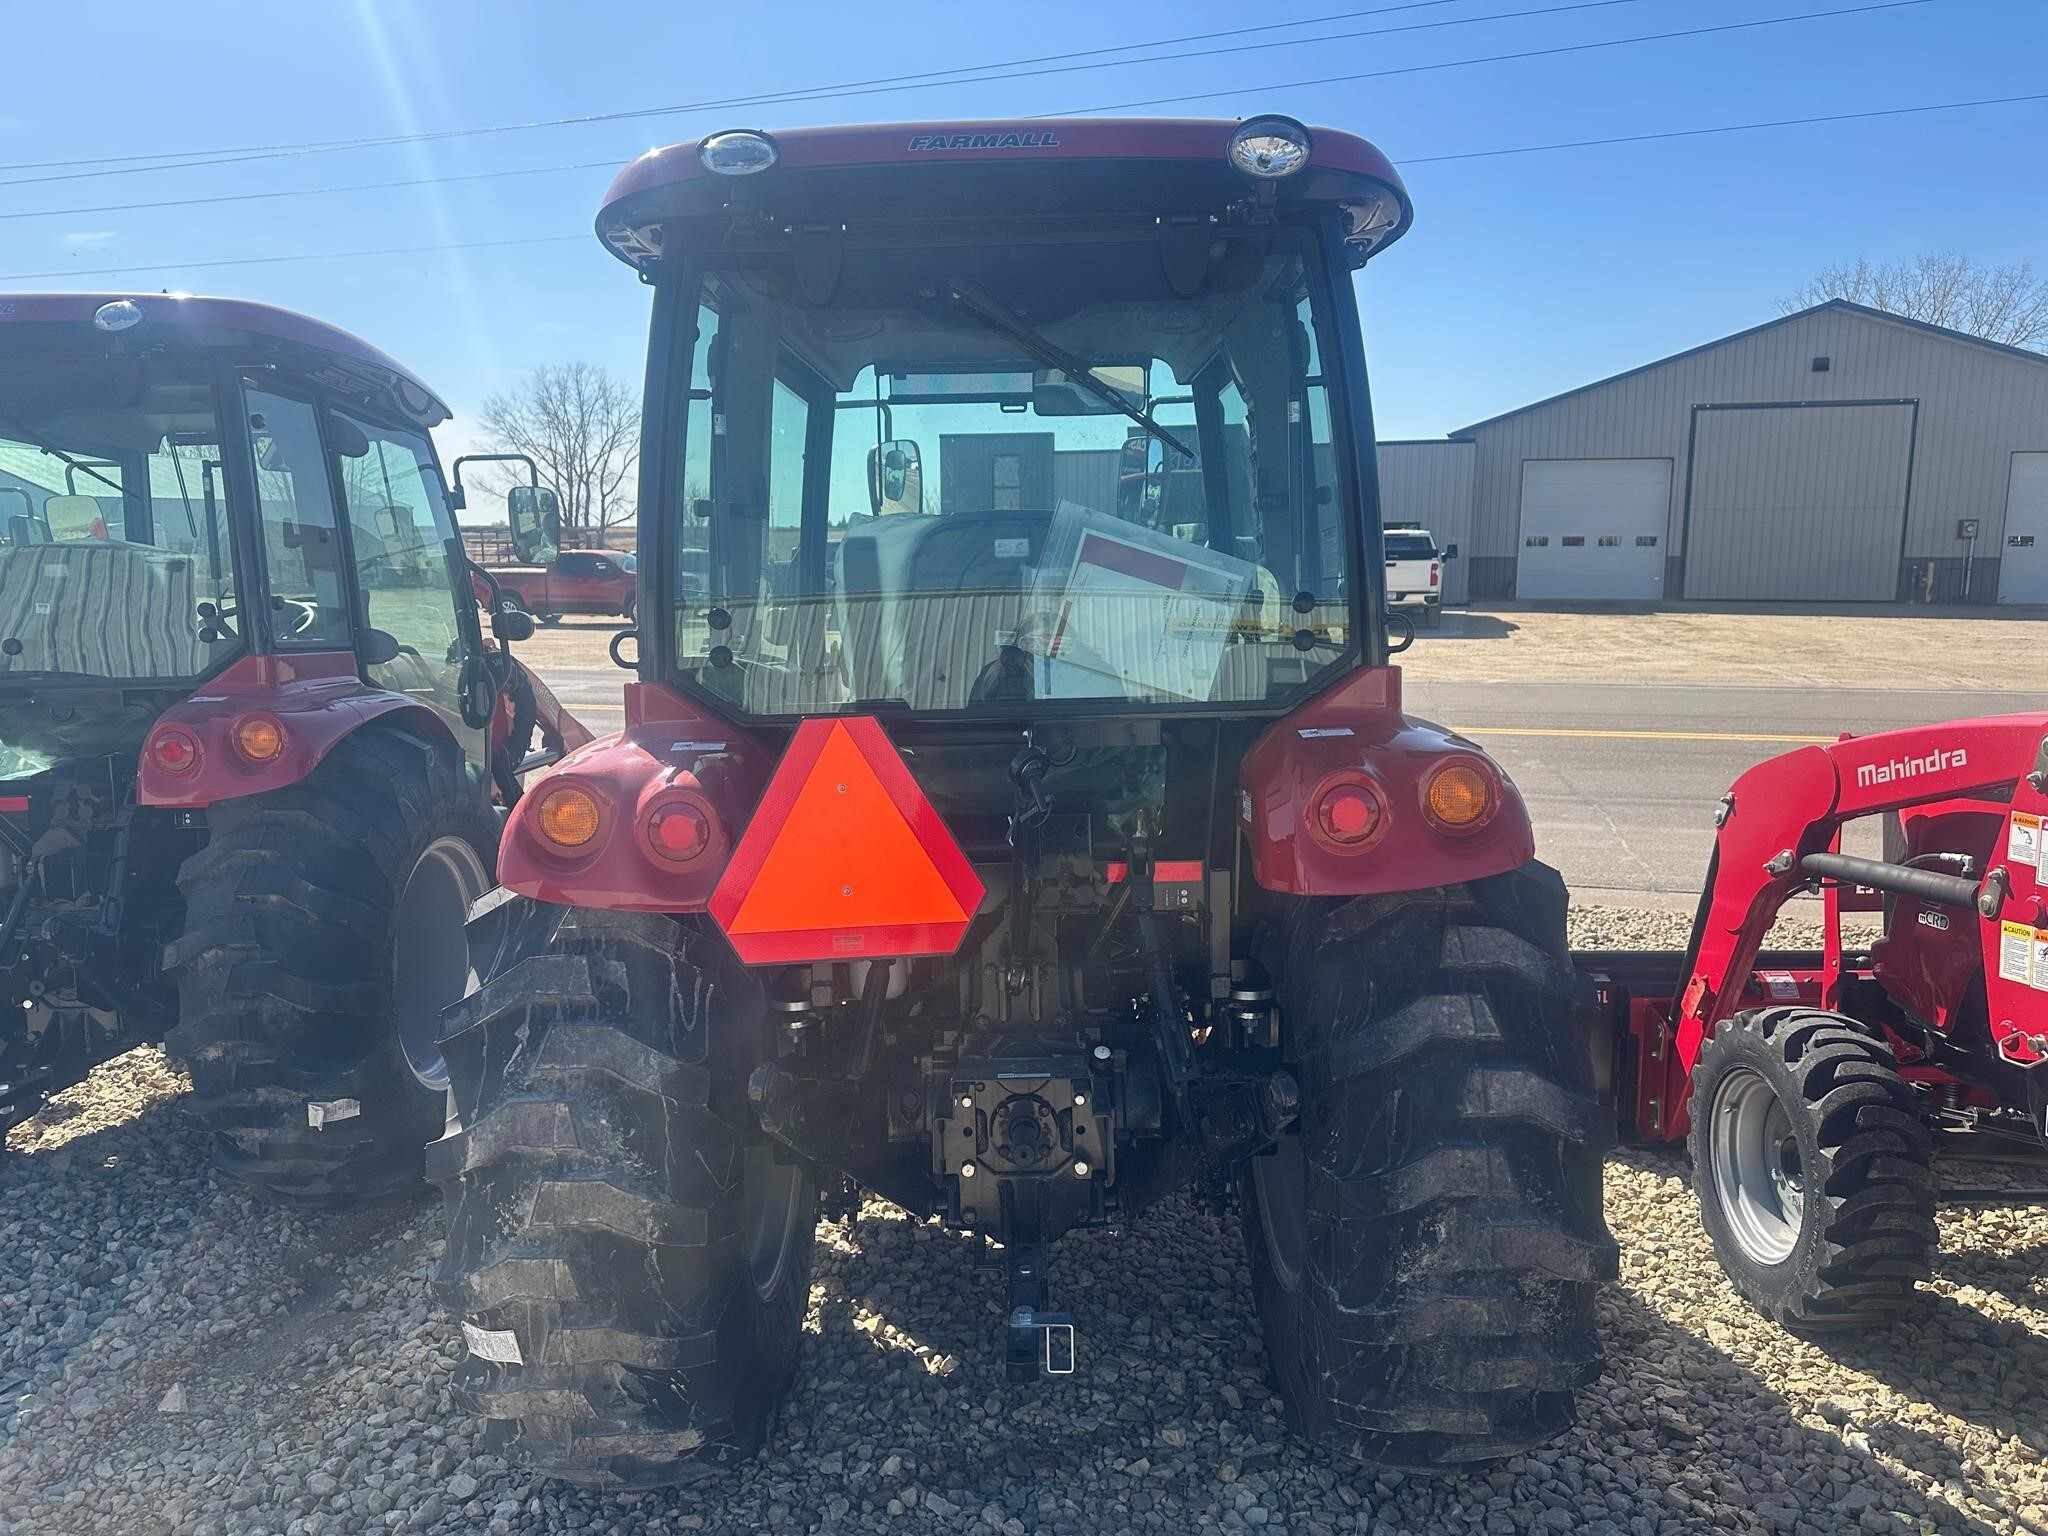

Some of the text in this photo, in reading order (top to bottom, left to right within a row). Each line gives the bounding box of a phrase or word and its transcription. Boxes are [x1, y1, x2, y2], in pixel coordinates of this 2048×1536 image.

[908, 132, 1060, 152] FARMALL
[1857, 748, 1967, 788] Mahindra
[2008, 926, 2031, 937] CAUTION
